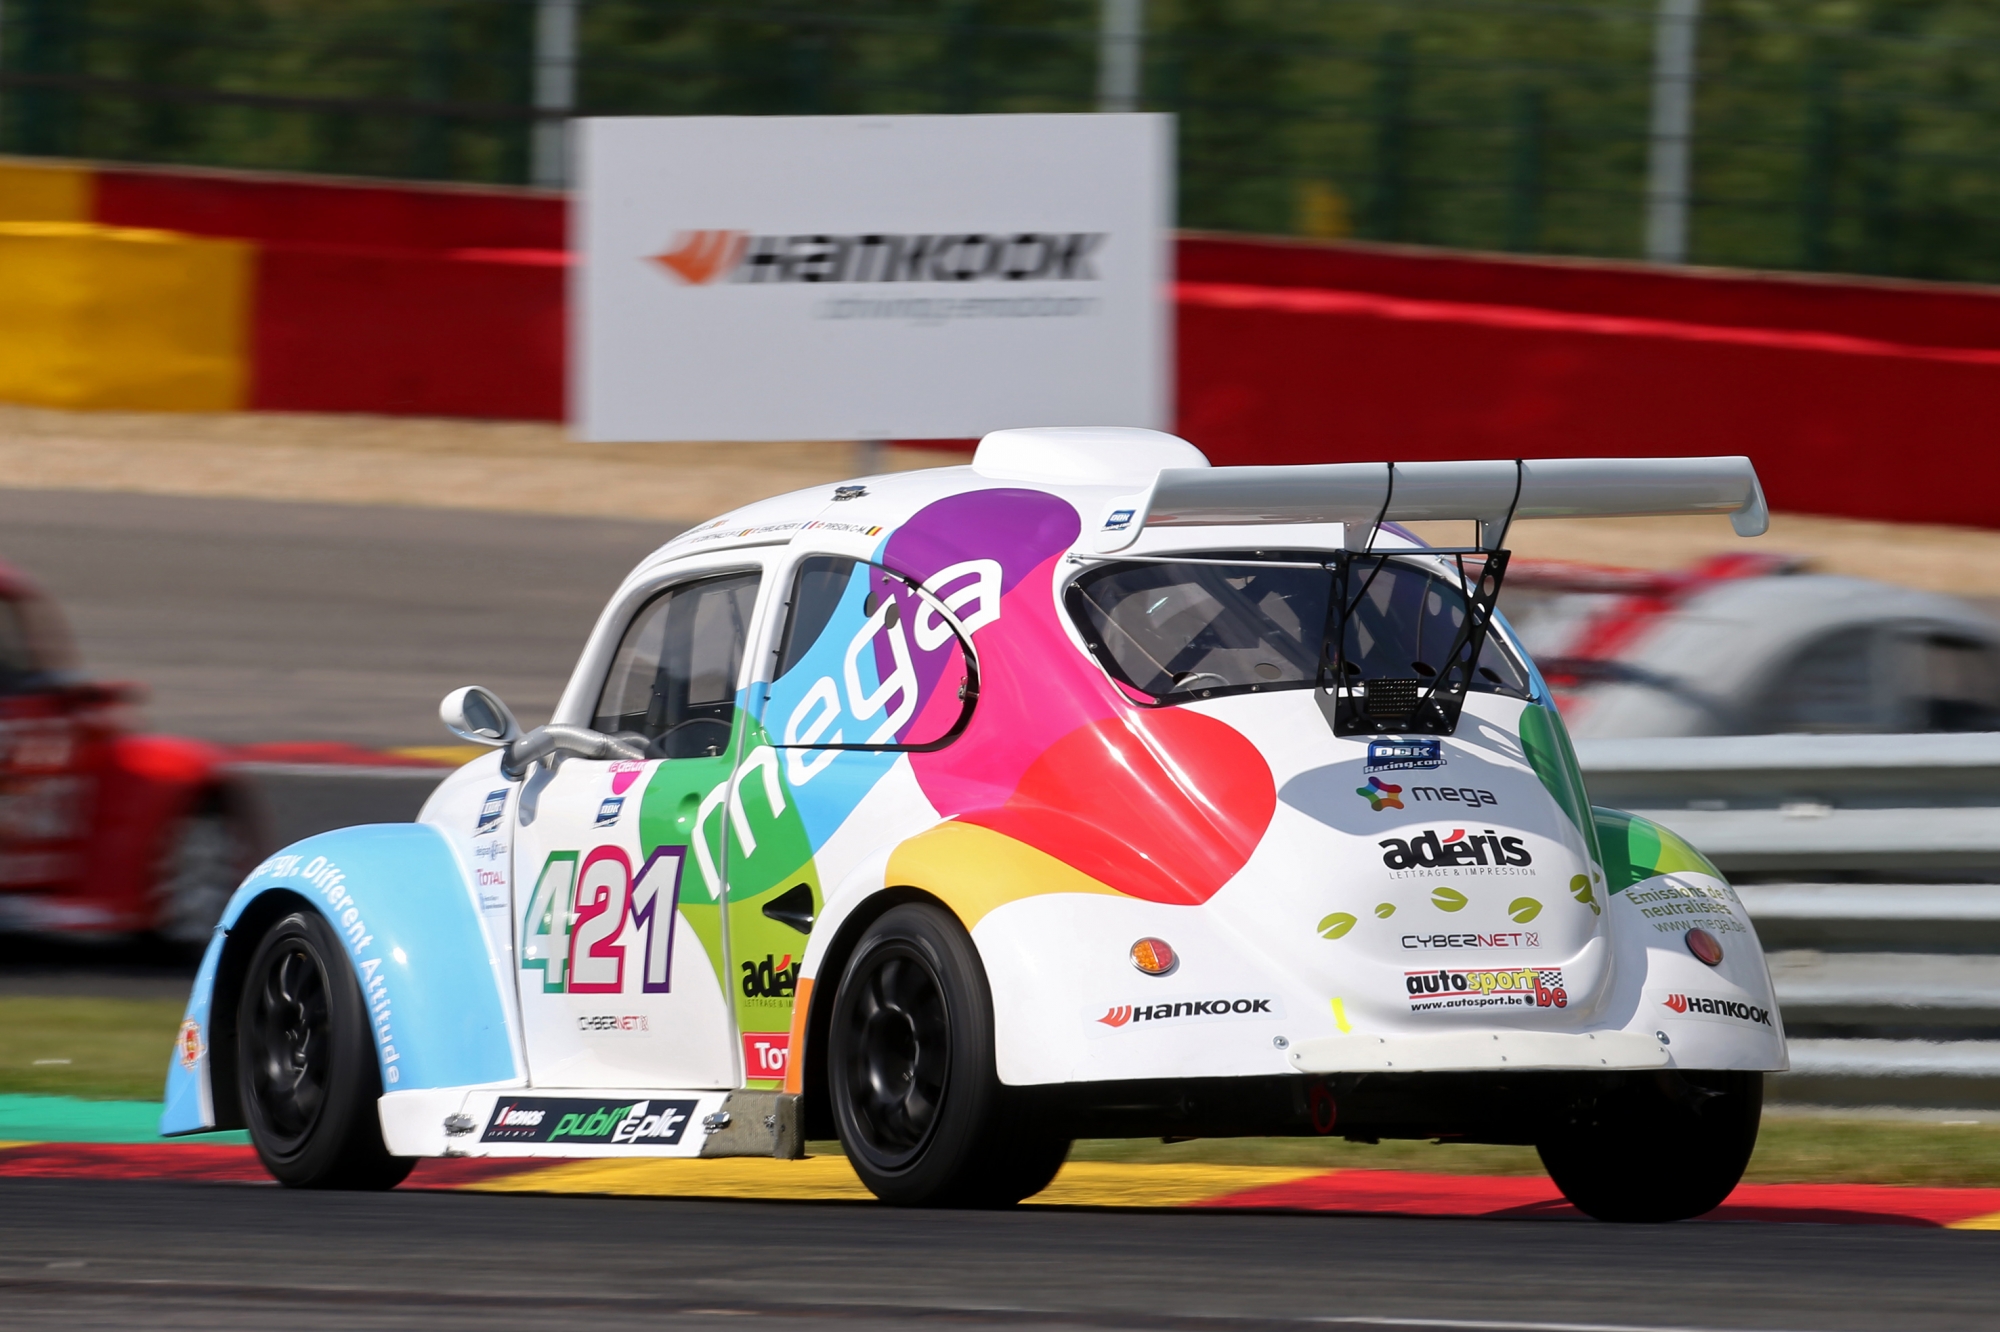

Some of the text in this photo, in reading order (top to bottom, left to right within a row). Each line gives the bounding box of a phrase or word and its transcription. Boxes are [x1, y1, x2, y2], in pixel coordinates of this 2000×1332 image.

[691, 559, 1003, 901] mega
[1364, 759, 1447, 774] Racing.com
[1411, 786, 1498, 808] mega
[1378, 829, 1532, 870] adéris
[1389, 867, 1537, 880] LETTRAGE & IMPRESSION
[1625, 885, 1707, 906] Émissions
[1707, 884, 1724, 900] de
[1641, 898, 1733, 918] neutralisées
[521, 845, 688, 994] 421
[1652, 917, 1747, 935] wwwmega.be
[301, 855, 374, 956] Different
[359, 957, 401, 1084] Attitude
[1406, 967, 1539, 996] autosport
[744, 999, 777, 1008] LETTRAGE
[1411, 996, 1523, 1012] www.autosport.be
